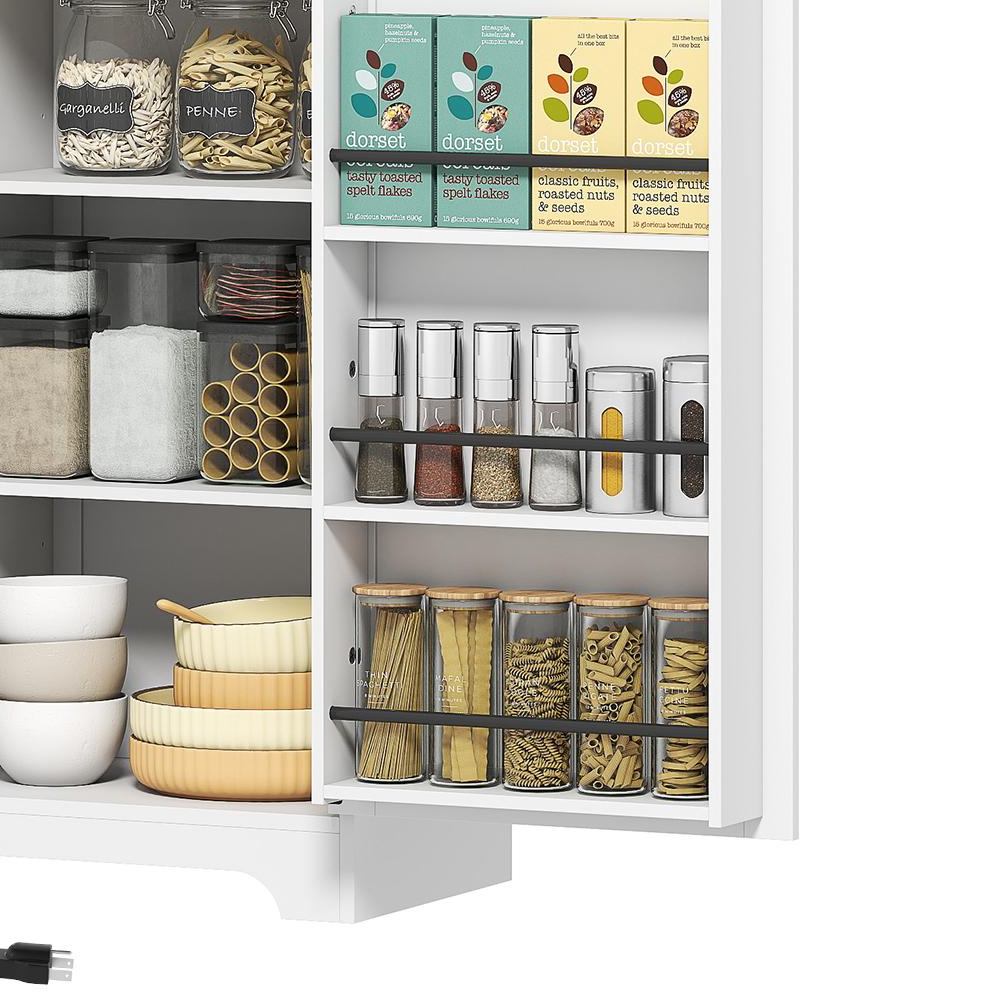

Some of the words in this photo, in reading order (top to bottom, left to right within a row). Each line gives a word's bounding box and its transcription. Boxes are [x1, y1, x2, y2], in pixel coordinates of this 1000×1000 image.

[59, 102, 126, 118] Garganelli
[186, 105, 238, 118] PENNE
[346, 131, 406, 149] dorset
[442, 134, 503, 151] dorset
[537, 136, 599, 153] dorset
[632, 138, 694, 156] dorset
[346, 171, 377, 184] tasty
[379, 172, 423, 183] toasted
[442, 173, 473, 186] tasty
[475, 174, 520, 186] toasted
[538, 175, 579, 186] classic
[582, 176, 619, 189] fruits,
[633, 178, 674, 189] classic
[346, 185, 376, 197] spelt
[378, 185, 413, 197] flakes
[442, 188, 473, 200] spelt
[474, 188, 510, 199] flakes
[538, 189, 583, 200] roasted
[587, 190, 615, 200] nuts
[633, 191, 678, 202] roasted
[682, 193, 710, 203] nuts
[538, 202, 548, 212] &
[551, 202, 585, 213] seeds
[633, 204, 643, 215] &
[646, 205, 680, 216] seeds
[354, 213, 379, 221] glorious
[450, 215, 476, 223] glorious
[546, 218, 571, 226] glorious
[640, 221, 666, 229] glorious
[364, 670, 389, 679] THIN
